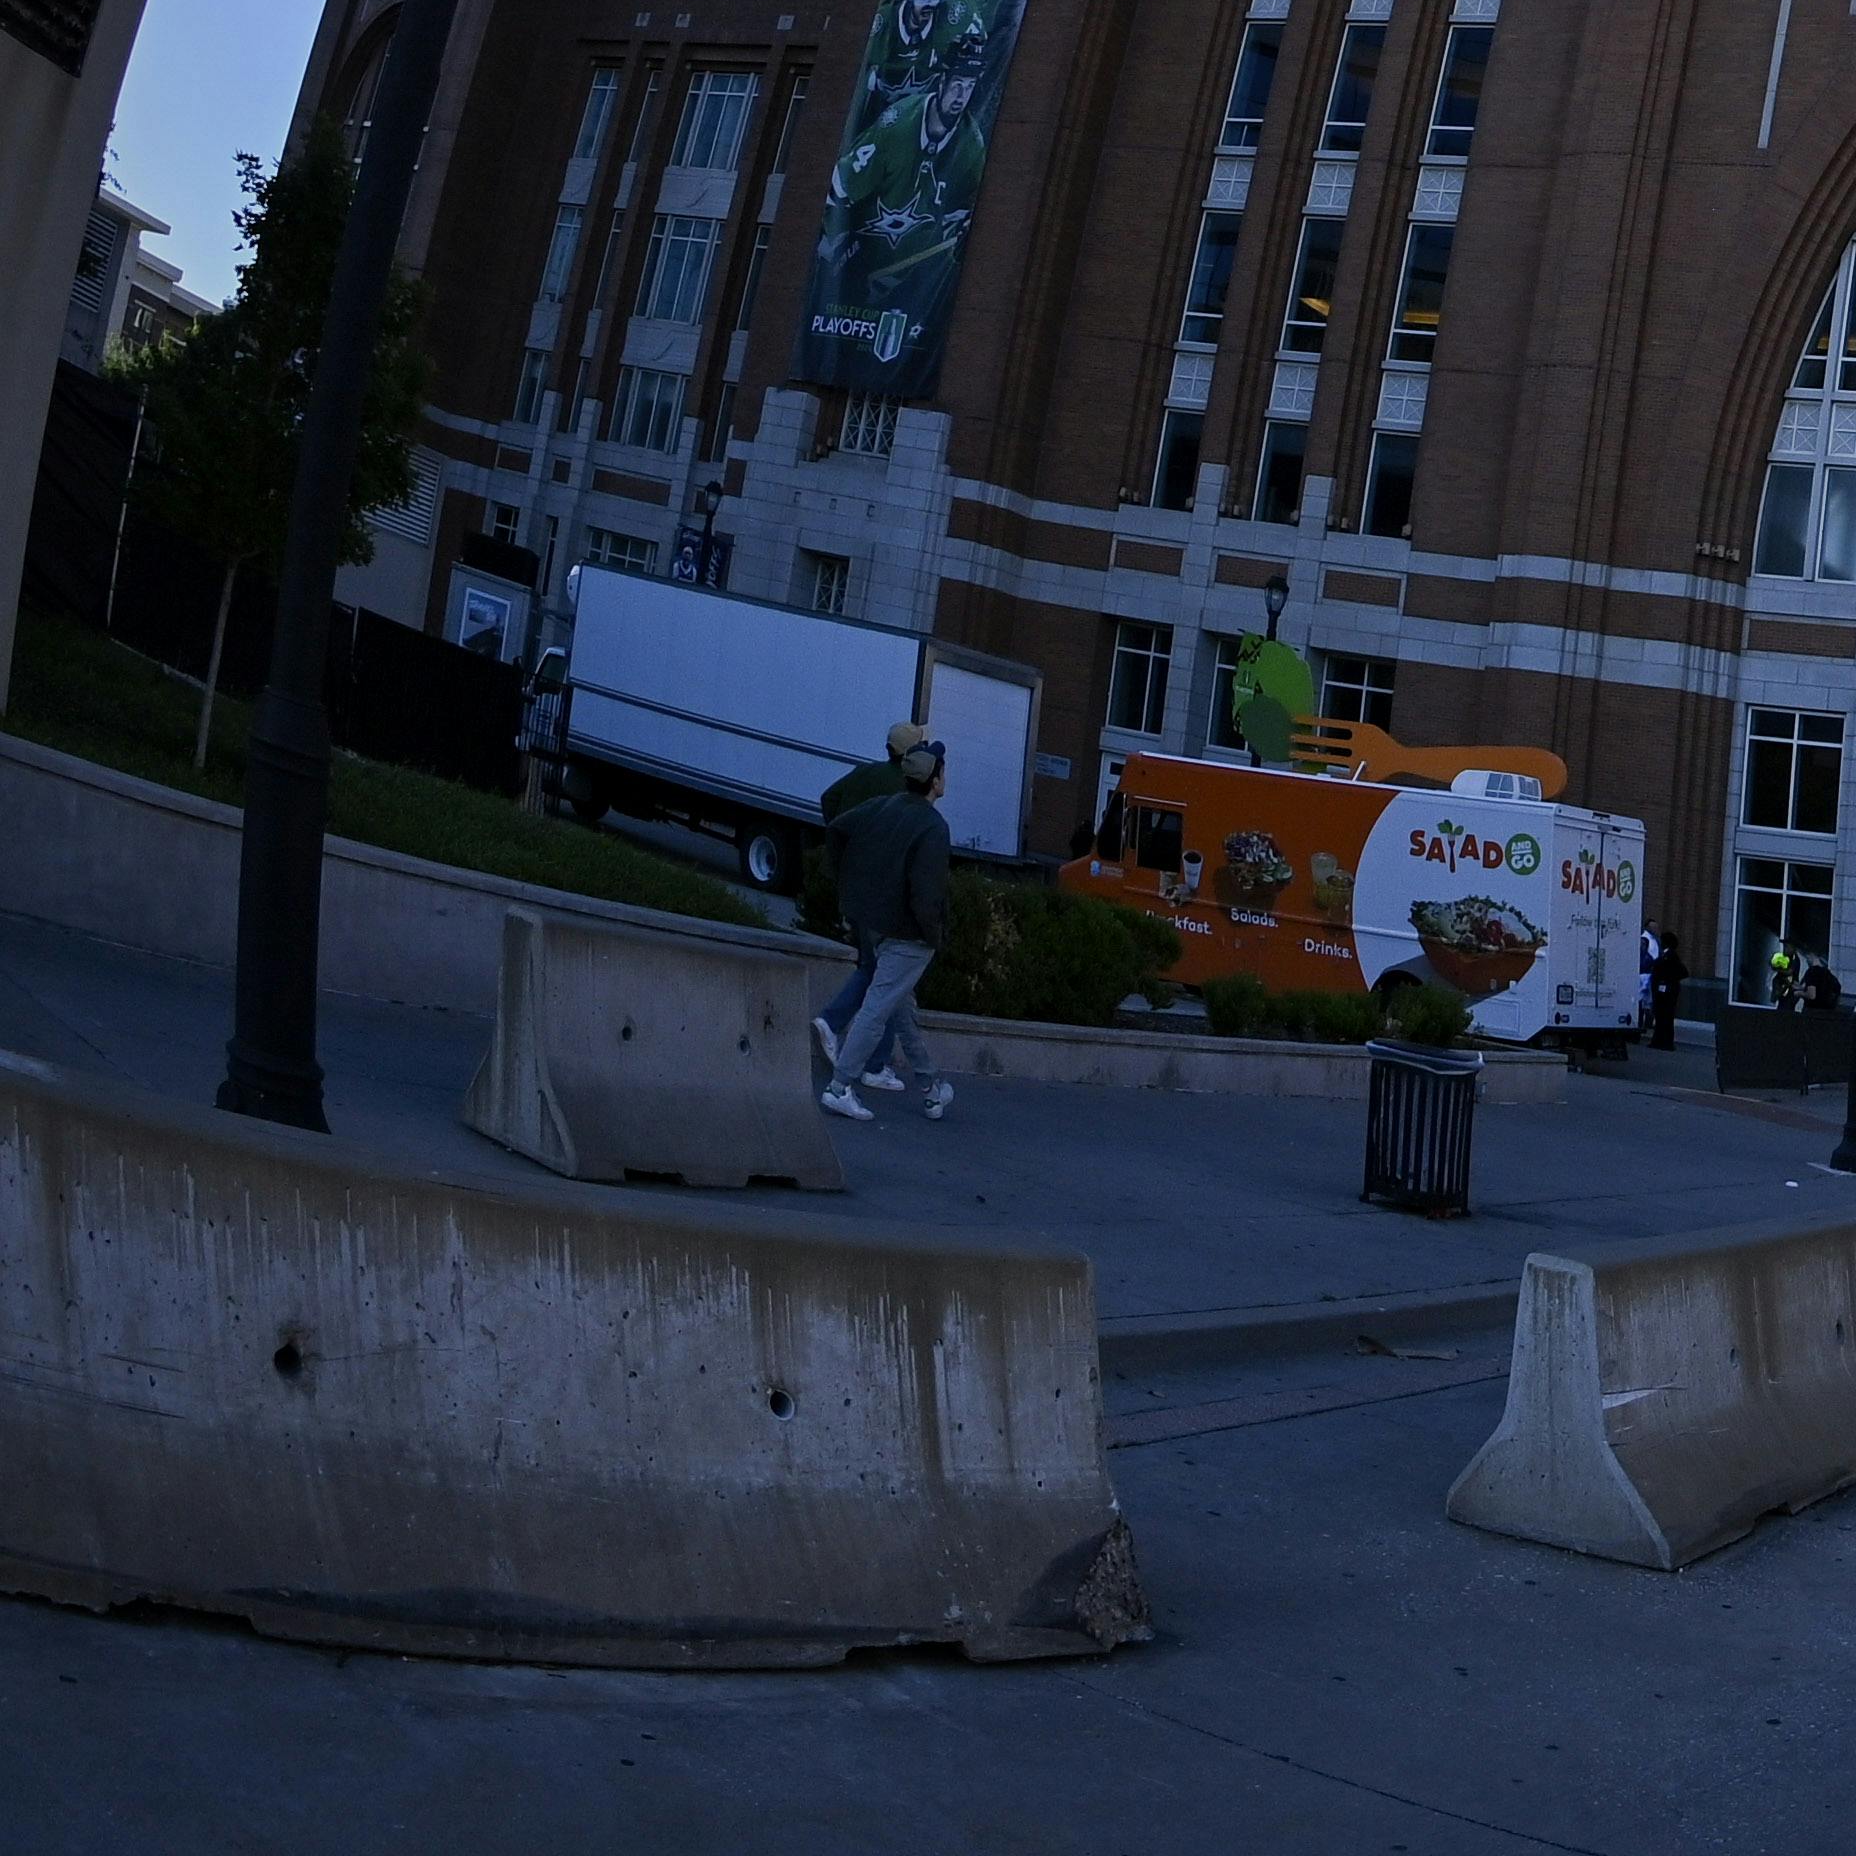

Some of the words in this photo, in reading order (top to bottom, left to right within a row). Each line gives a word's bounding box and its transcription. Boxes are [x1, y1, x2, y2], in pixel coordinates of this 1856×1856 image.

[811, 314, 877, 340] PLAYOFFS
[1410, 829, 1504, 874] SALAD
[1511, 840, 1532, 853] AND
[1511, 854, 1536, 870] GO
[1146, 909, 1213, 935] kfast.
[1230, 907, 1279, 928] Salads.
[1303, 937, 1353, 959] Drinks.
